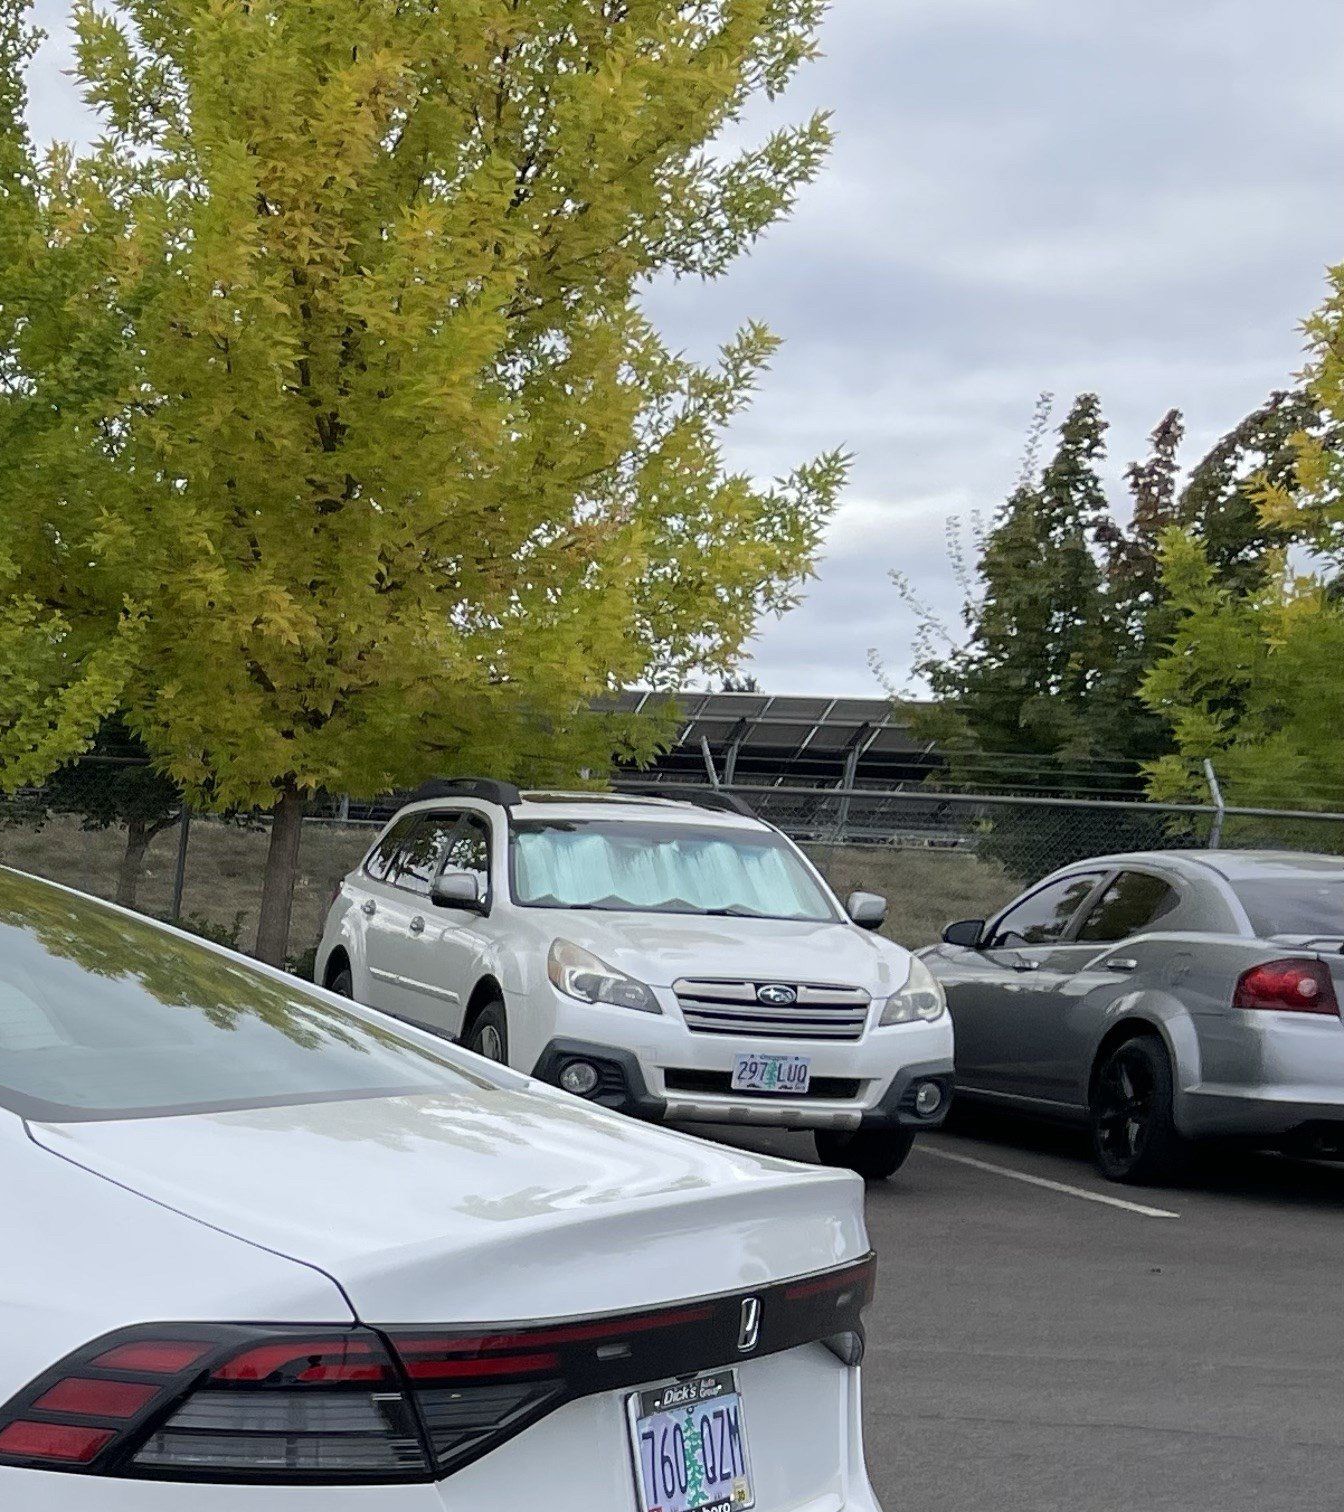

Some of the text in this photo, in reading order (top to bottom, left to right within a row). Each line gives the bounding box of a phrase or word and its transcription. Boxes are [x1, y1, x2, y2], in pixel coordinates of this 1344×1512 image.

[738, 1061, 768, 1081] 297
[663, 1383, 697, 1406] Dick's
[642, 1406, 745, 1504] 760 QZM
